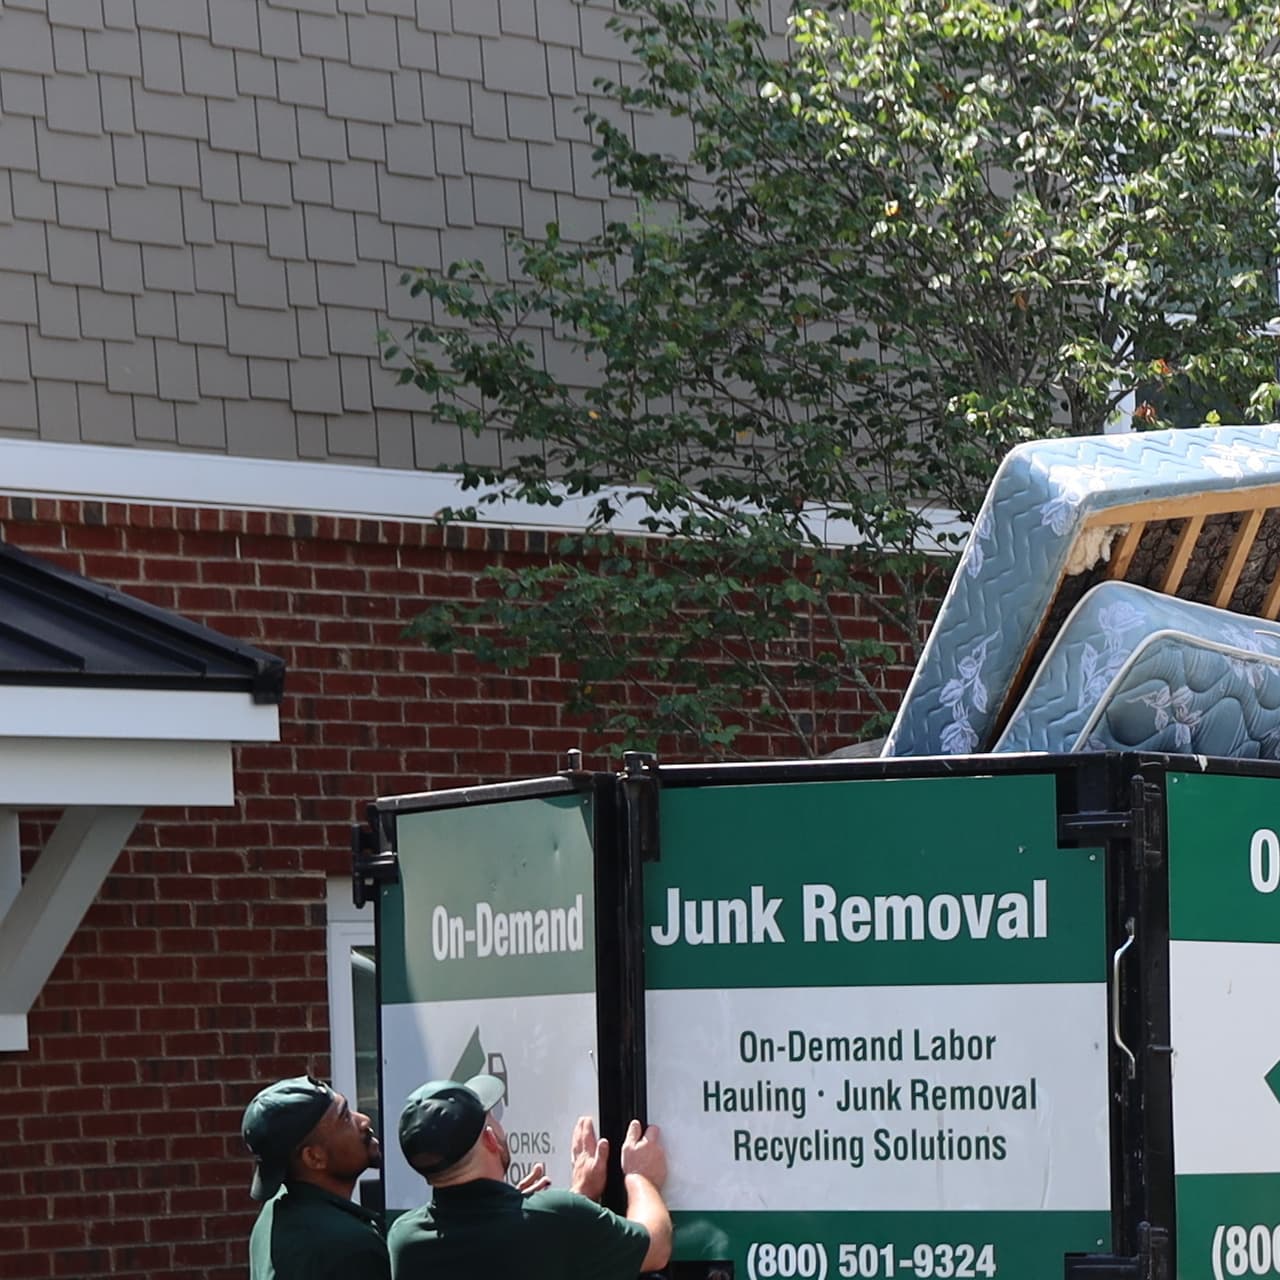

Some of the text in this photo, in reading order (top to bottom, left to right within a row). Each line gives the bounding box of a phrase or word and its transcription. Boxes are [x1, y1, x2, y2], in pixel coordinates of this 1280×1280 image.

[433, 894, 583, 960] On-Demand
[652, 880, 1046, 945] Junk Removal
[740, 1029, 996, 1063] On-Demand Labor
[704, 1078, 1036, 1118] Hauling Junk Removal
[505, 1132, 552, 1155] ORKS
[734, 1129, 1006, 1168] Recycling Solutions
[839, 1244, 996, 1277] 501-9324
